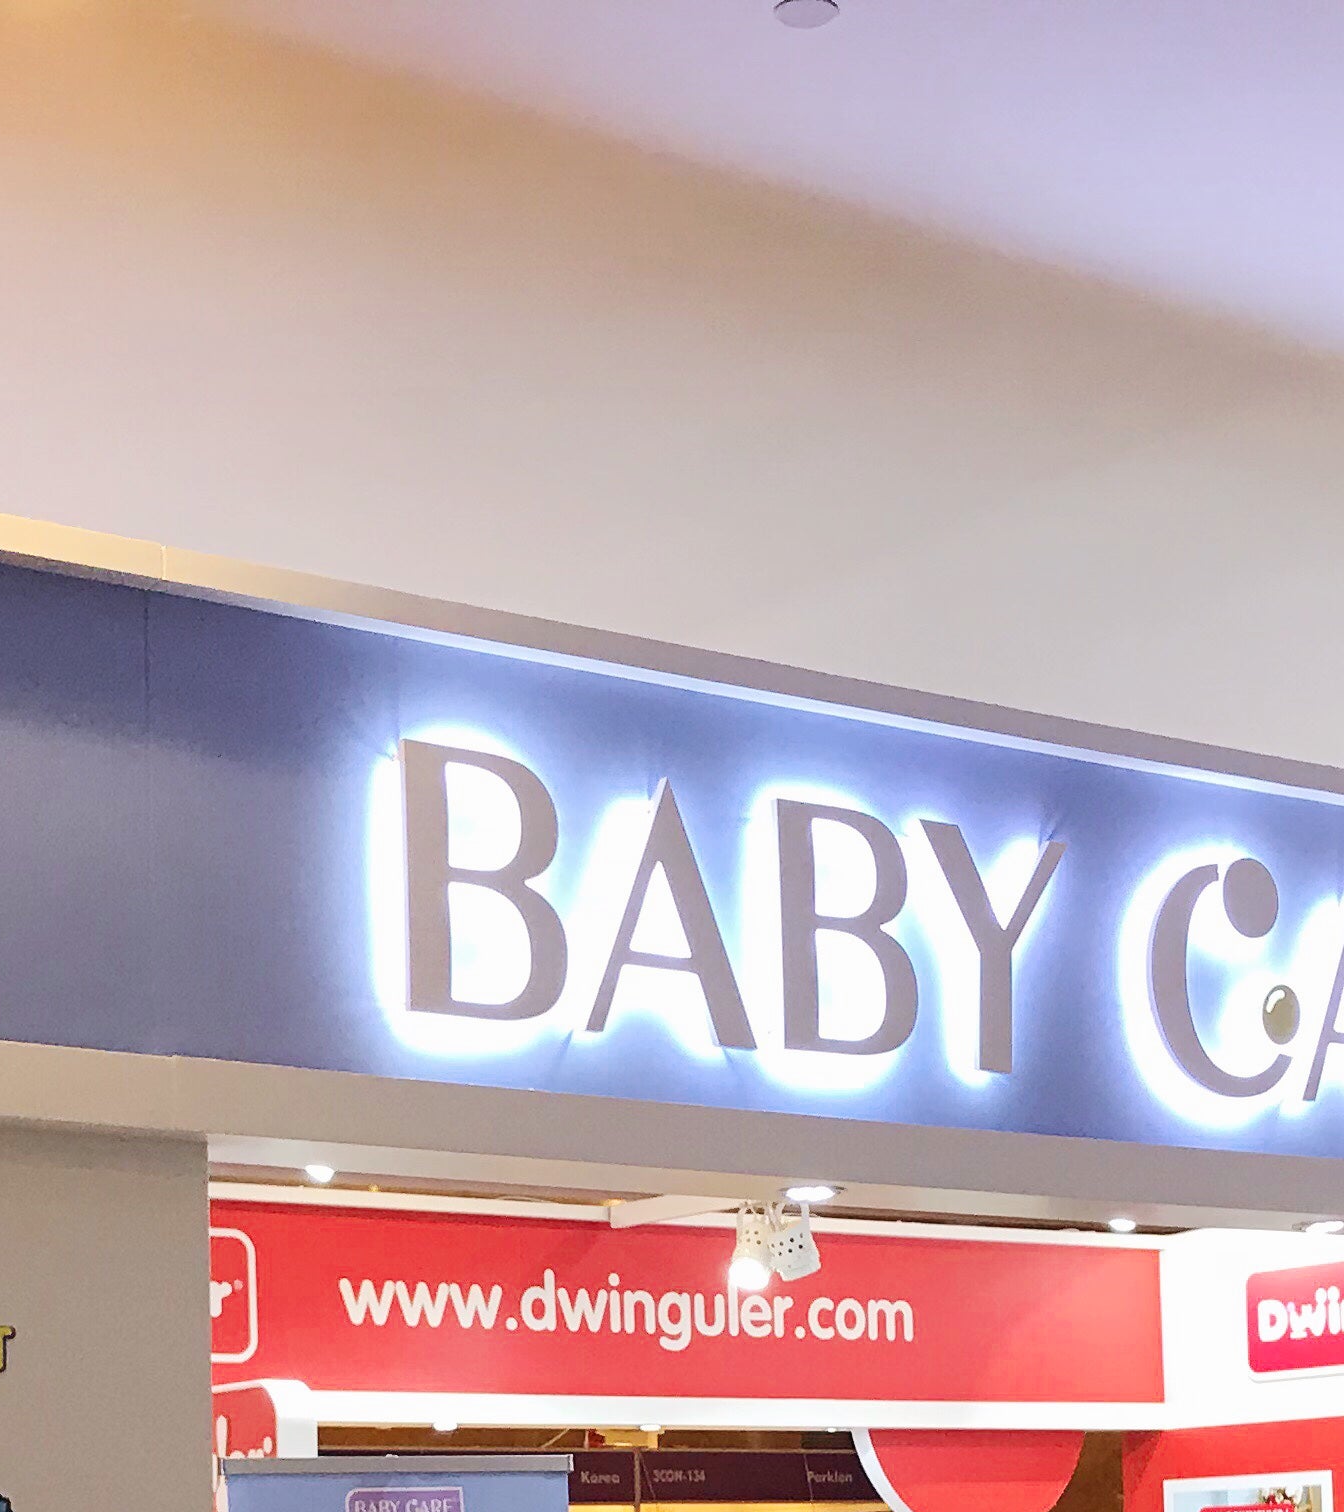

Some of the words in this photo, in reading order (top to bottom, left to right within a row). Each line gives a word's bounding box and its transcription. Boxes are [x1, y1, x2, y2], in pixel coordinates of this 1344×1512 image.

[401, 738, 1067, 1074] BABY
[339, 1269, 915, 1352] www.dwinguler.com
[580, 1470, 621, 1485] Korea
